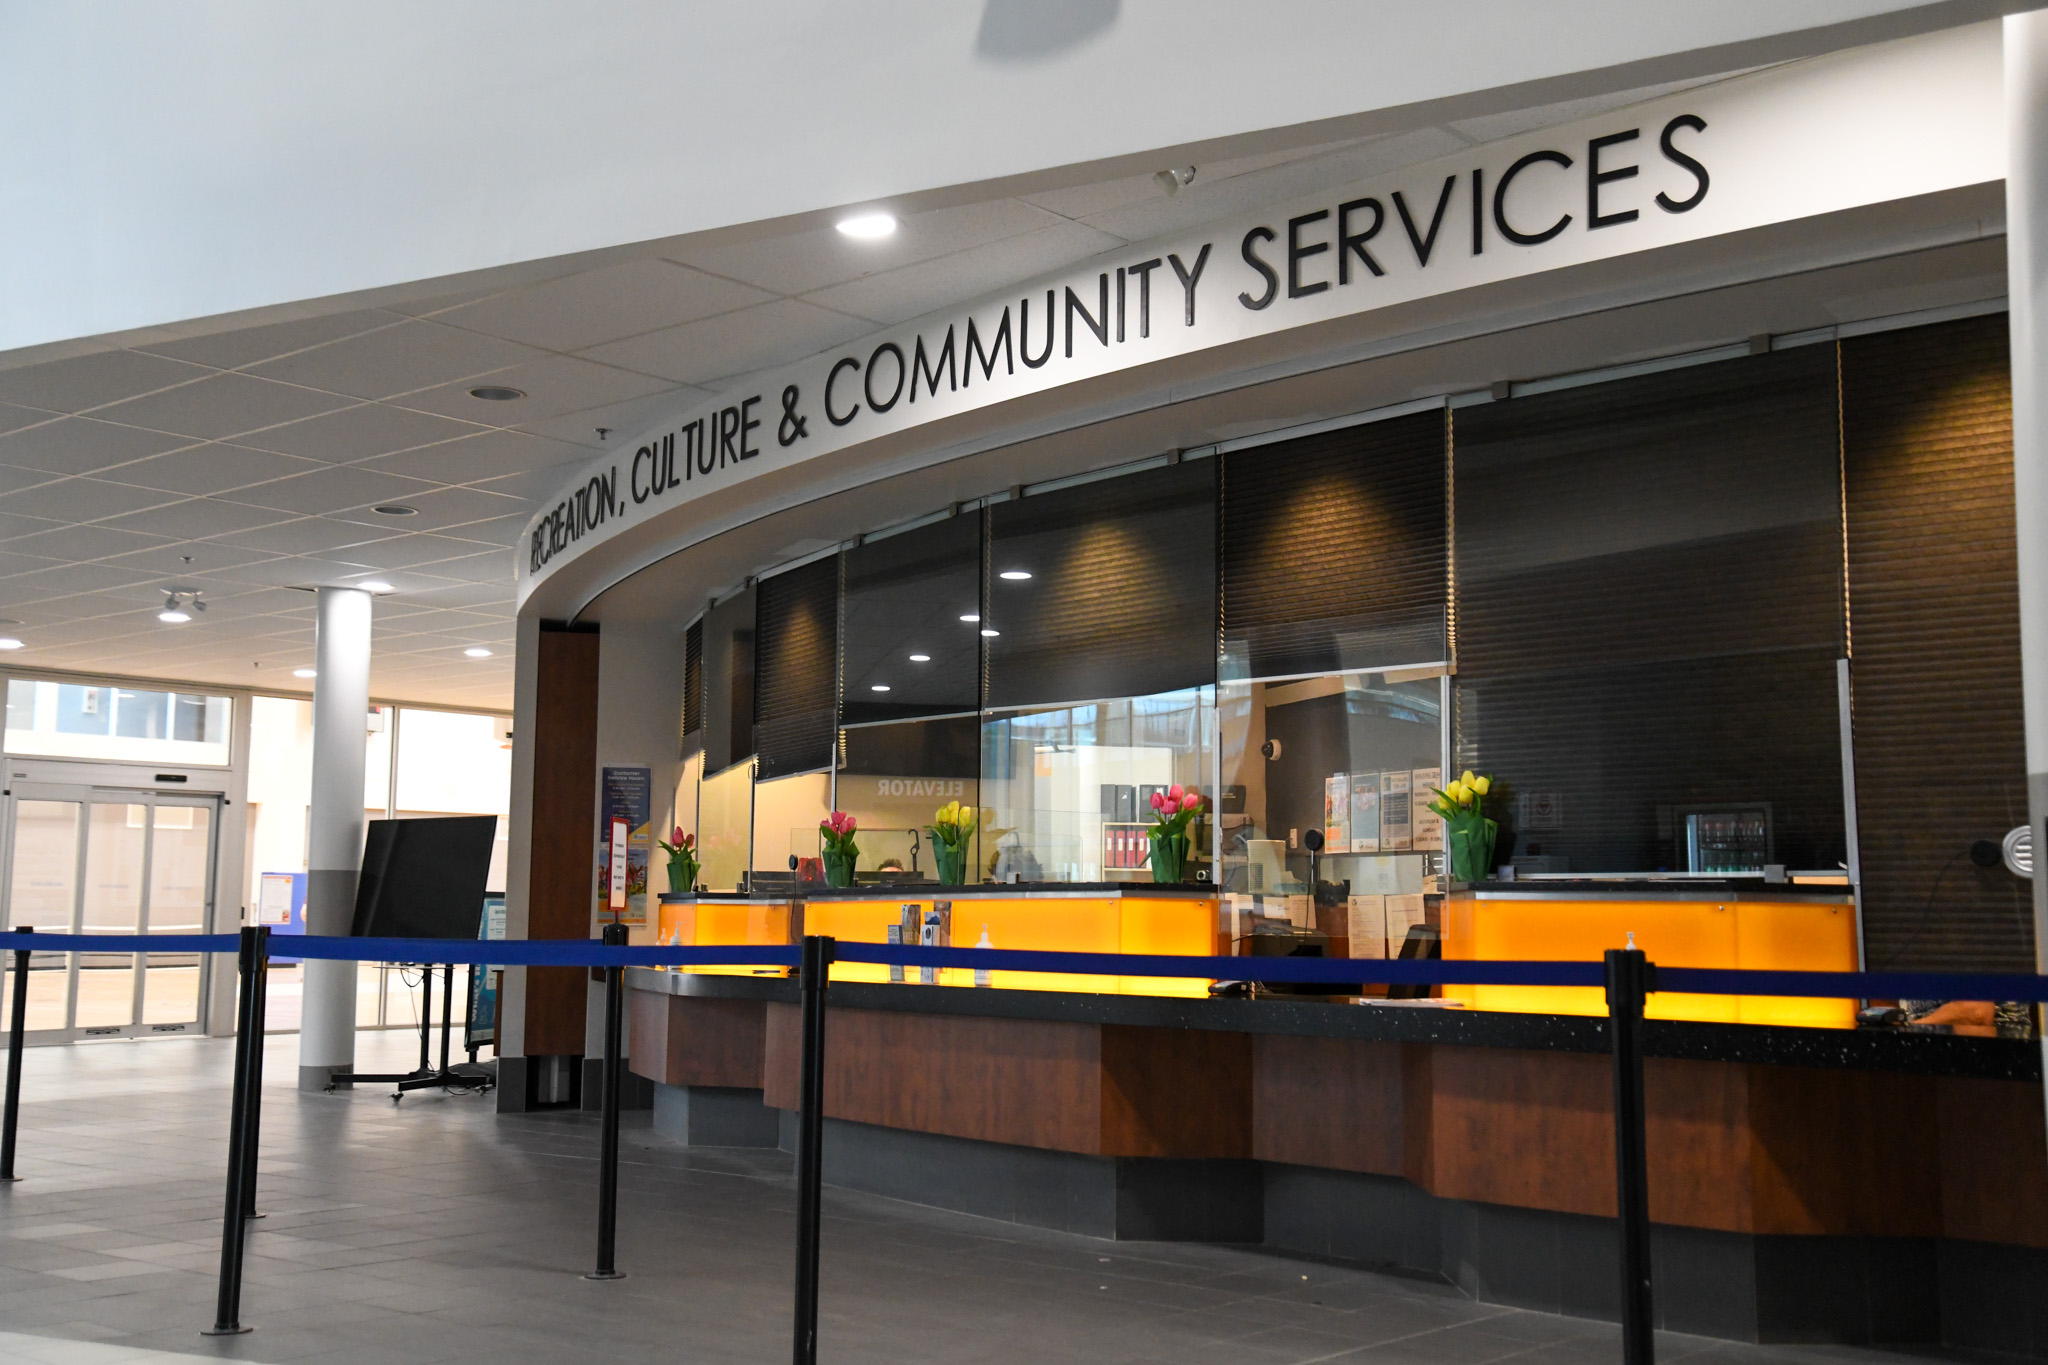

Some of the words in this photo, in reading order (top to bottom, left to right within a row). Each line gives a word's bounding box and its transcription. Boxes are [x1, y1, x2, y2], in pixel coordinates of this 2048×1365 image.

[530, 466, 625, 576] RECREATION,
[631, 394, 760, 503] CULTURE
[778, 385, 808, 446] &
[824, 244, 1212, 427] COMMUNITY
[1241, 114, 1710, 311] SERVICES
